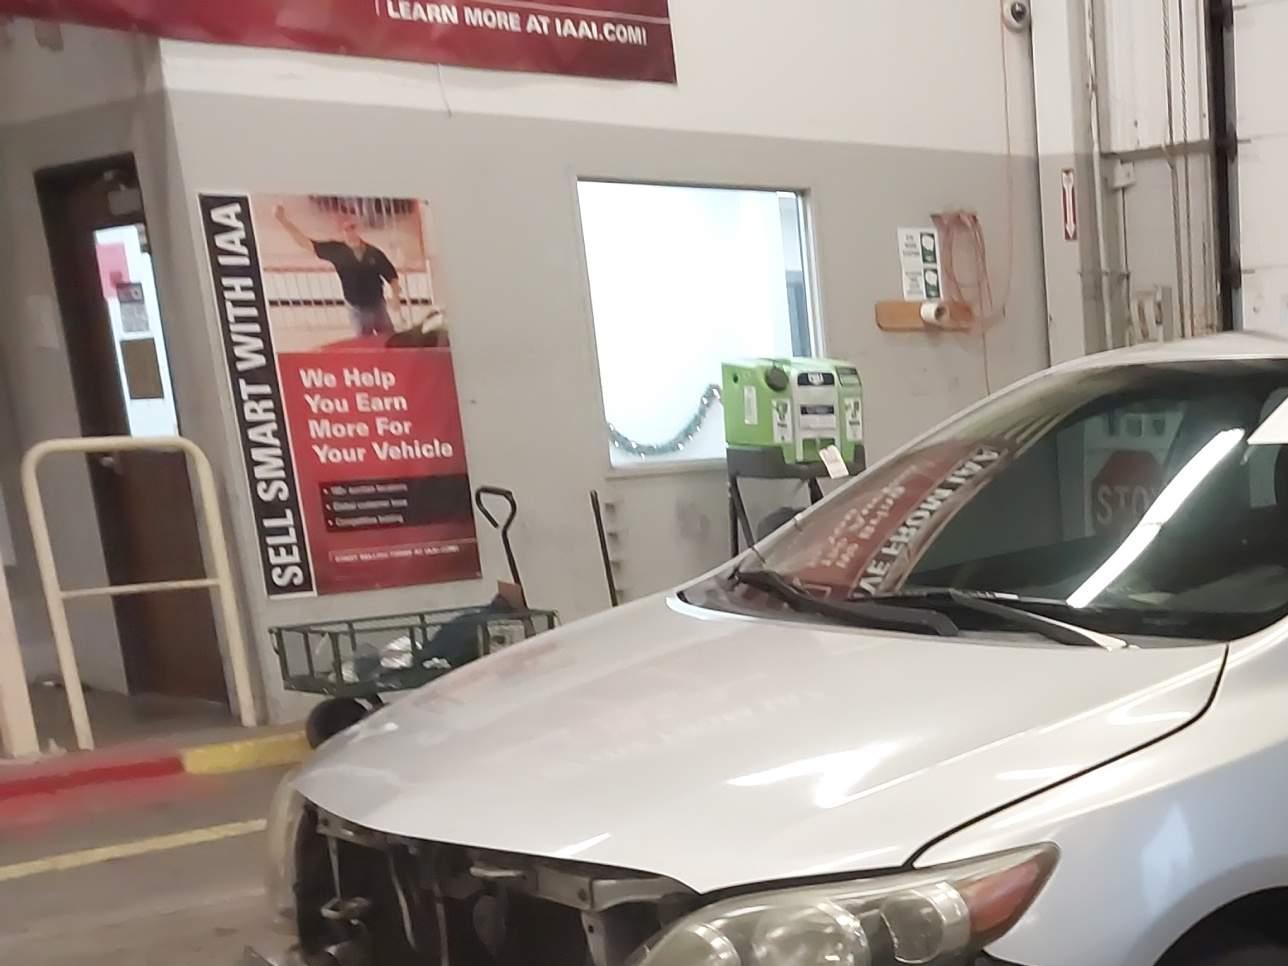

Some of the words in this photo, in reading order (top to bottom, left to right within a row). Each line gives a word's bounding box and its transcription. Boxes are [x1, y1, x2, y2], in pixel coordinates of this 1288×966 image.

[387, 0, 459, 25] LEARN
[464, 7, 522, 33] MORE
[526, 18, 551, 35] AT
[210, 202, 252, 267] IAA
[221, 276, 267, 372] WITH
[299, 368, 337, 389] We
[343, 366, 396, 391] Help
[304, 393, 349, 414] You
[355, 391, 408, 412] Earn
[239, 378, 290, 502] SMART
[308, 418, 369, 439] More
[375, 416, 412, 437] For
[312, 444, 367, 464] Your
[372, 438, 454, 460] Vehicle
[262, 508, 305, 588] SELL
